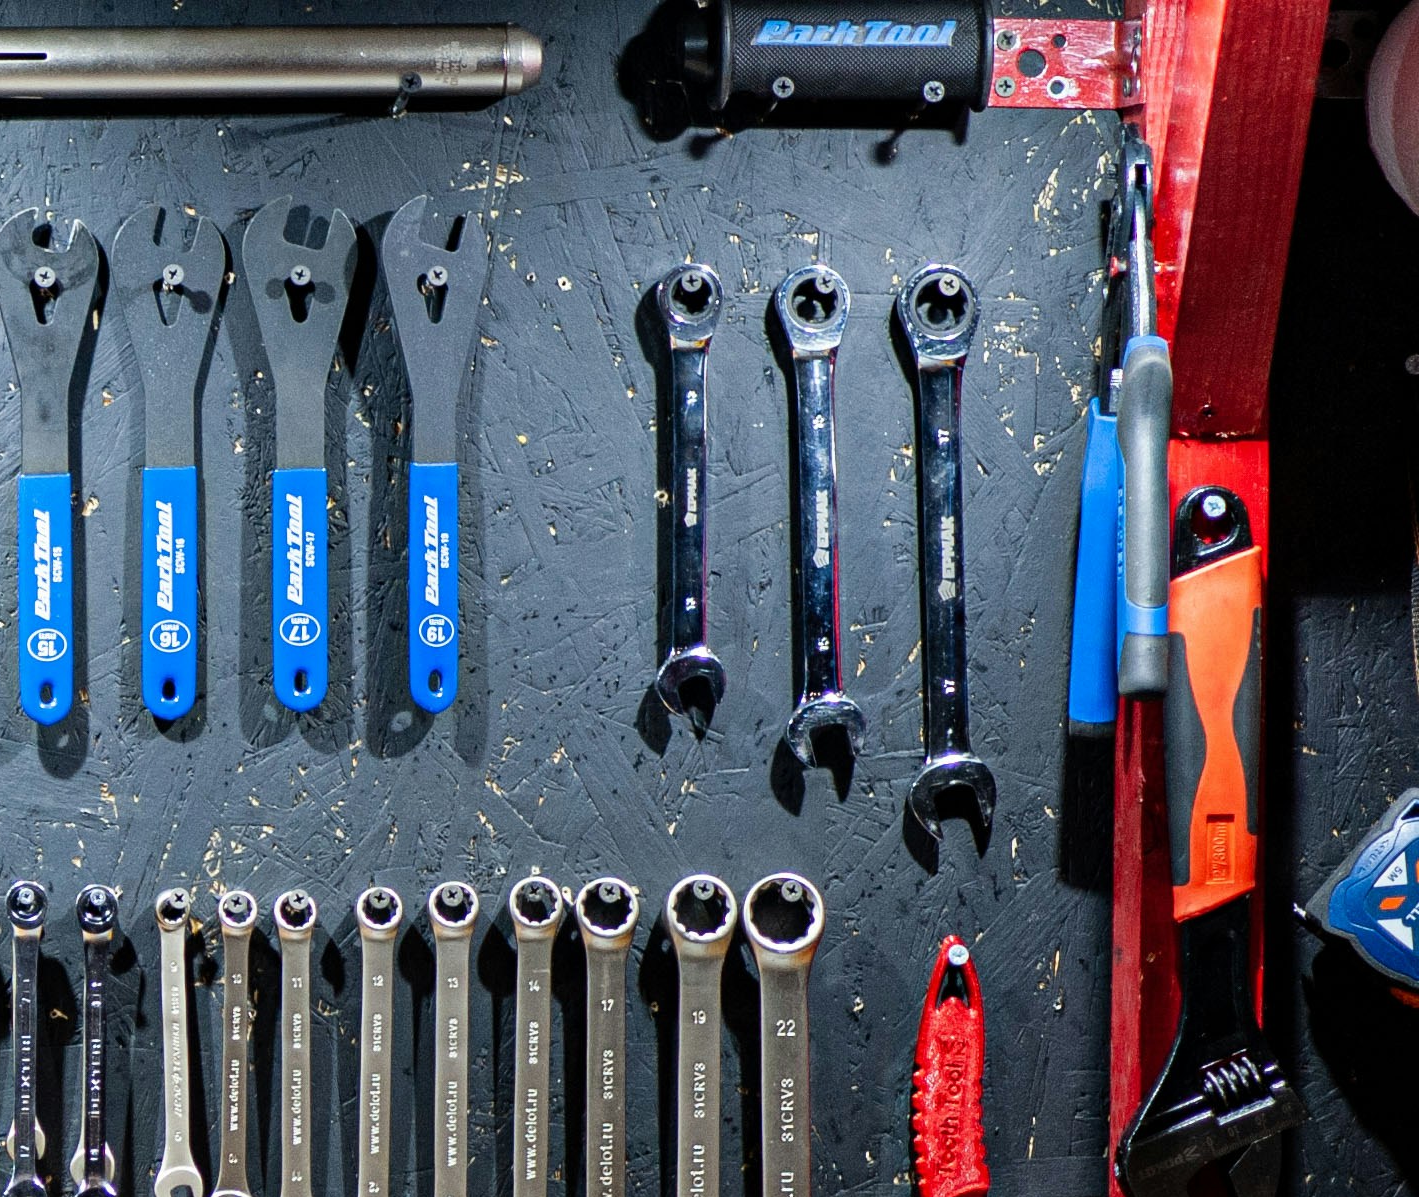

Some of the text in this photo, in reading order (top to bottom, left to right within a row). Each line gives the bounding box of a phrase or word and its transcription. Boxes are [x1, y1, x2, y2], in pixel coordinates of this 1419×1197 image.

[175, 538, 185, 574] SCW-16
[305, 531, 316, 567] SCW-17
[440, 533, 450, 569] SCW-19
[52, 546, 62, 582] SCW-15
[159, 631, 180, 647] 16
[288, 625, 310, 641] 17
[426, 626, 445, 642] 19
[37, 640, 57, 656] 15
[601, 999, 615, 1012] 17
[692, 1010, 707, 1024] 19
[776, 1019, 797, 1037] 22
[936, 1116, 960, 1176] Tooth
